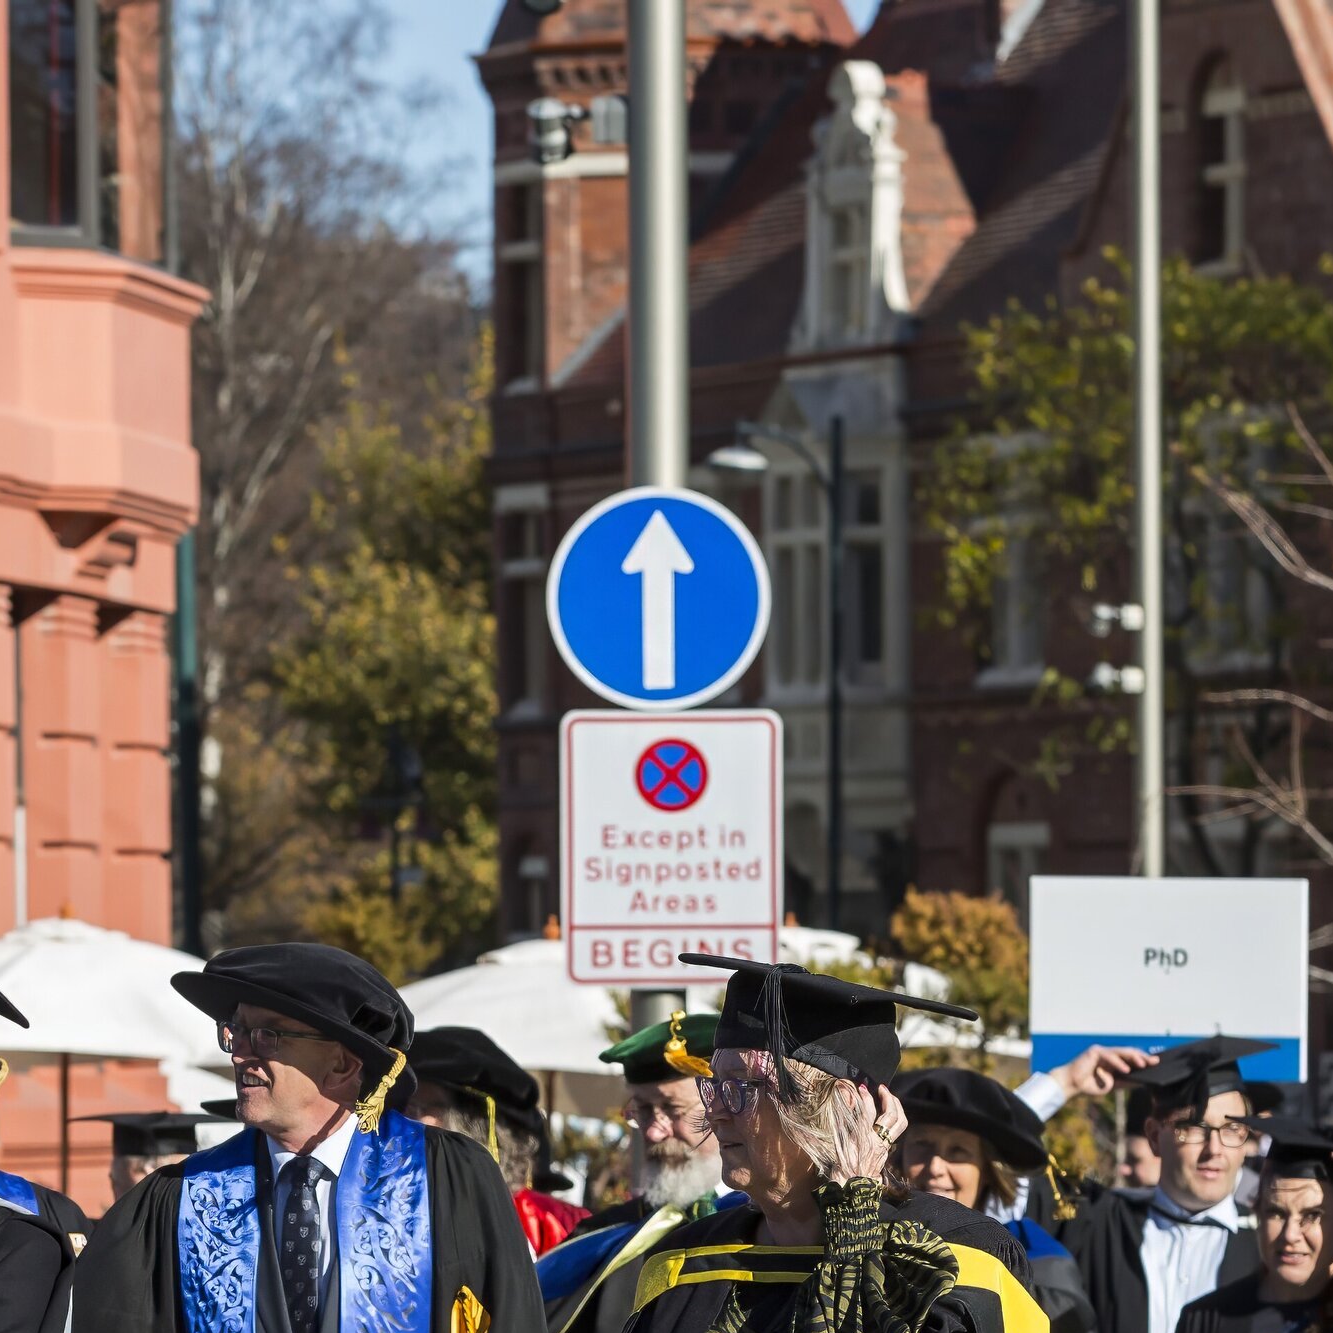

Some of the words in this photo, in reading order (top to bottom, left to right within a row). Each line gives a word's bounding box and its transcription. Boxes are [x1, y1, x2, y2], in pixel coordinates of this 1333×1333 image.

[601, 824, 708, 853] Except
[718, 825, 747, 849] in
[584, 856, 763, 886] Signposted
[628, 889, 719, 914] Areas
[1143, 947, 1189, 968] PhD
